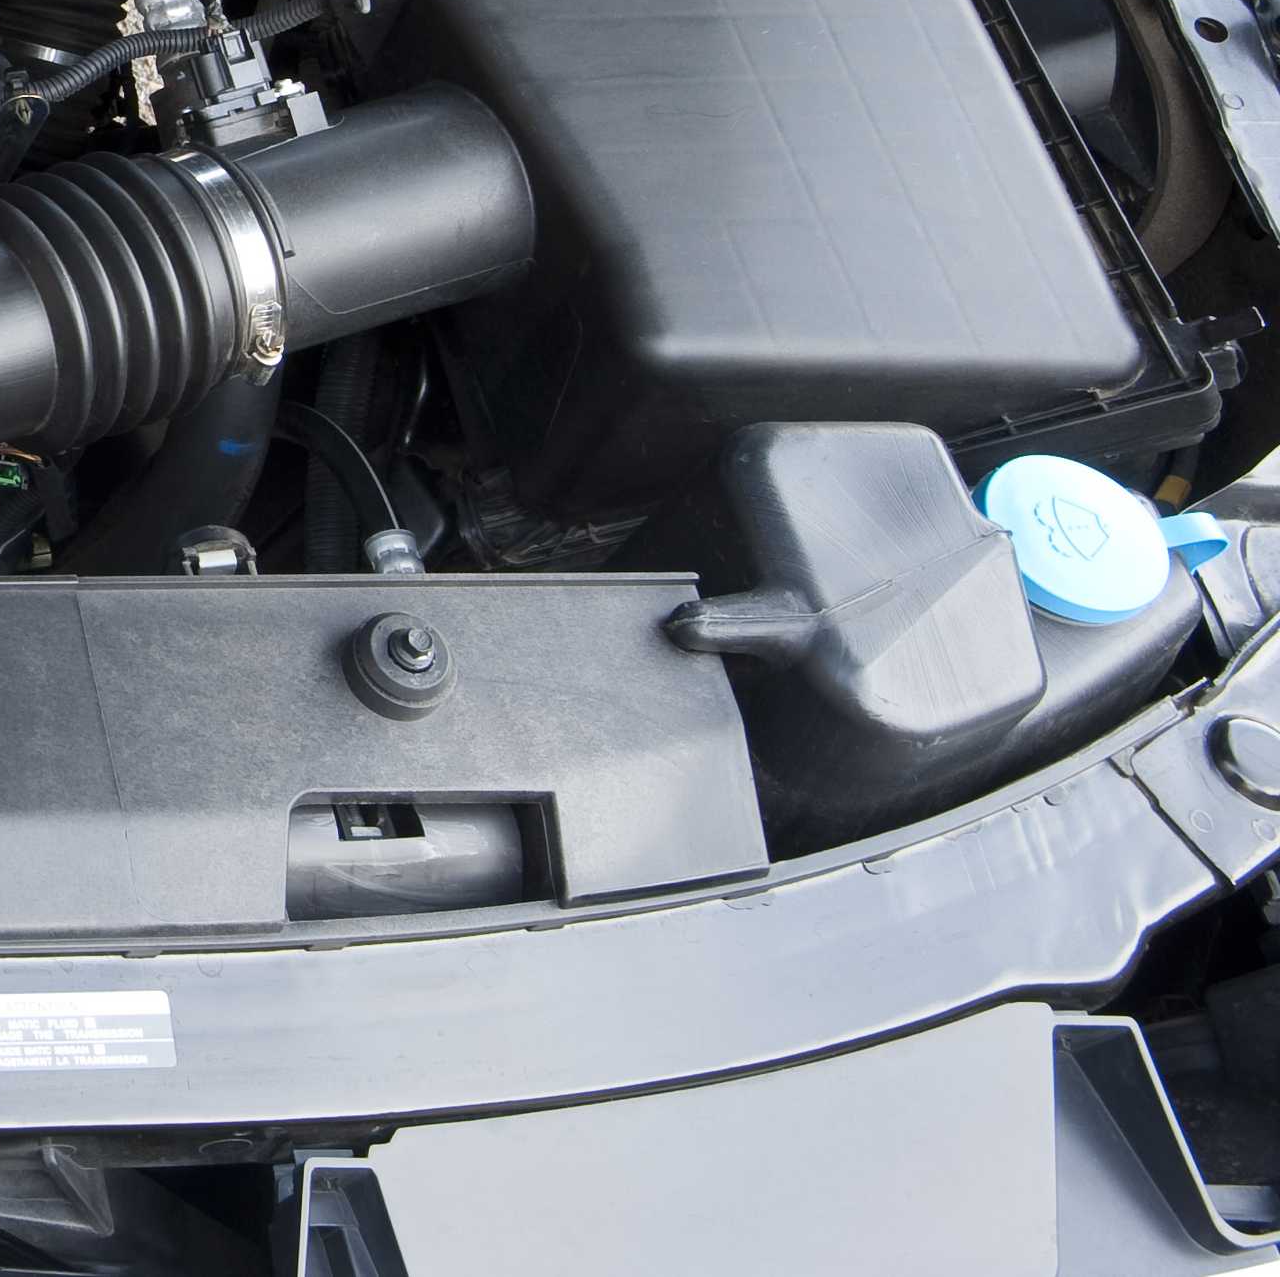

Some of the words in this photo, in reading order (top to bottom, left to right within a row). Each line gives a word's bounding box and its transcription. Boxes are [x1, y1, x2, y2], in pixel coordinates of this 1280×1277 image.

[8, 1019, 40, 1029] MATIC
[48, 1019, 79, 1029] FLUID
[33, 1030, 54, 1040] THE
[56, 1056, 70, 1066] LA
